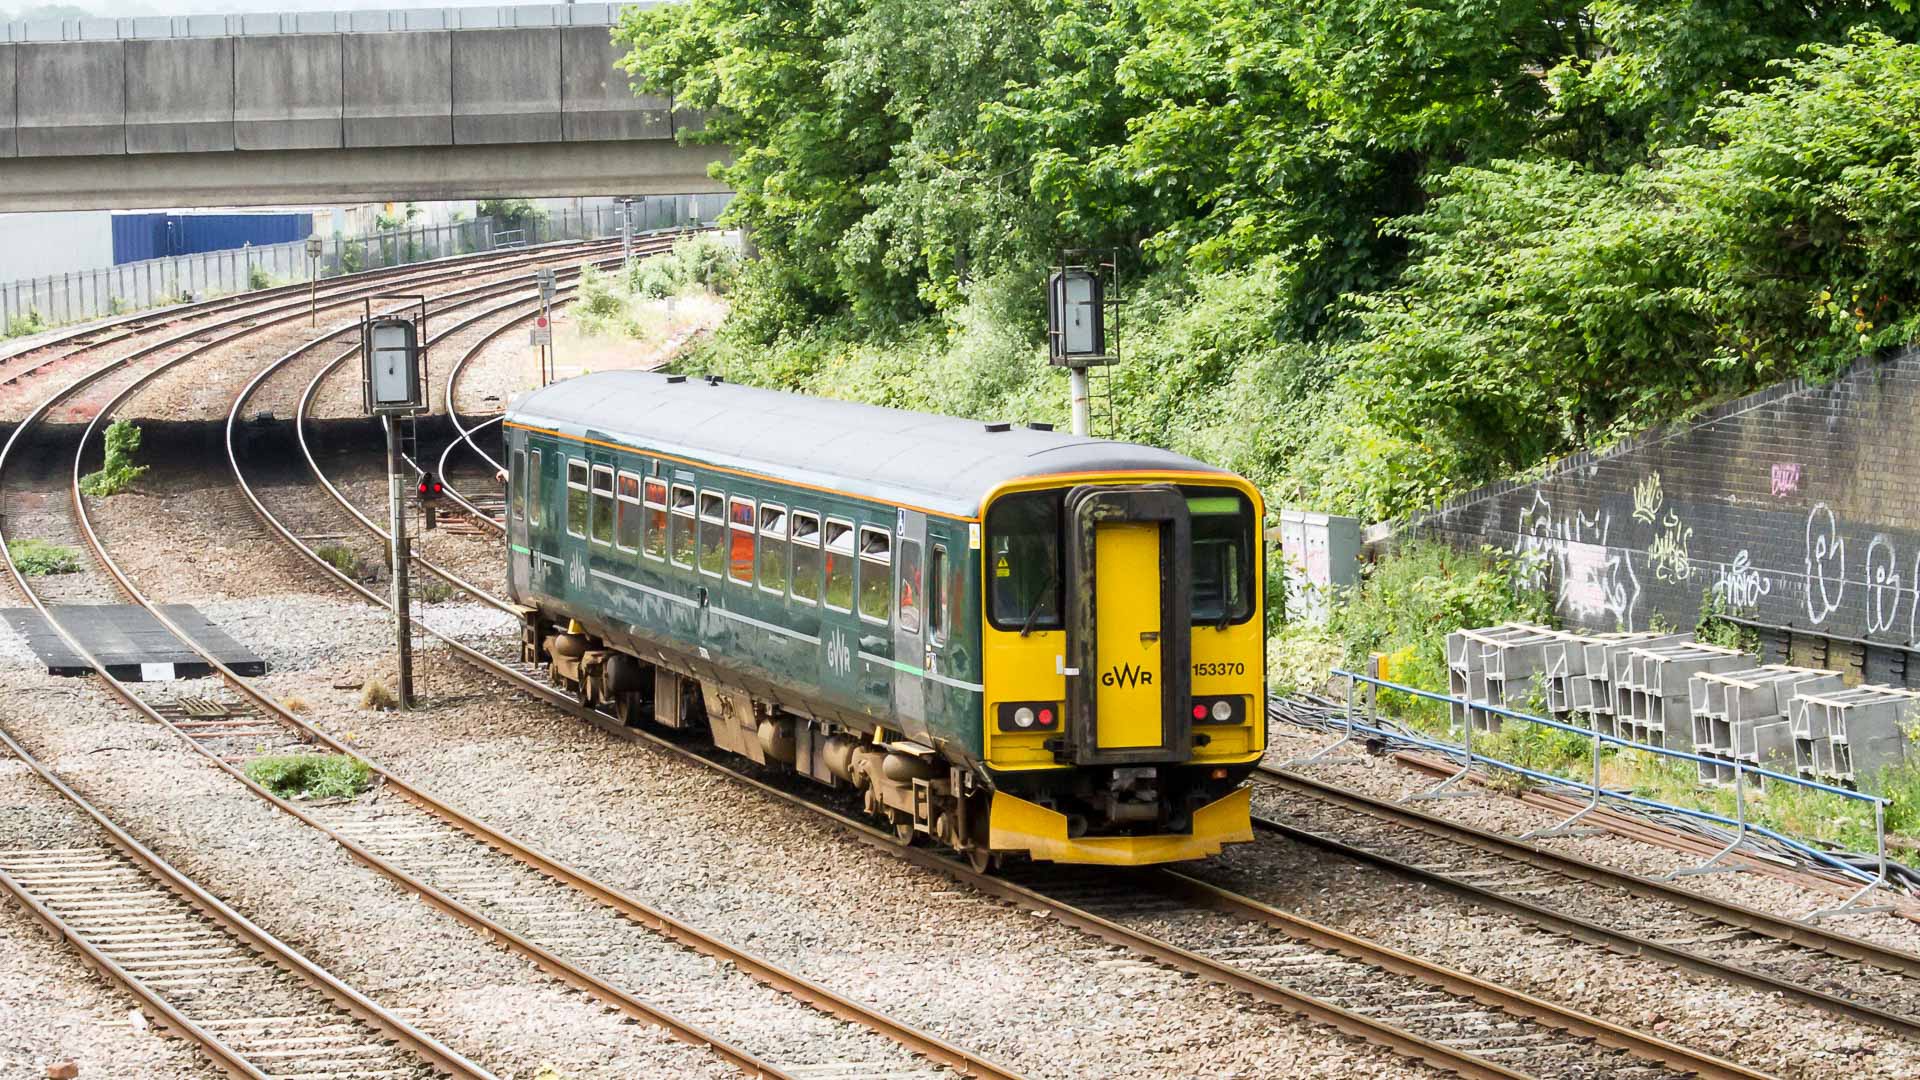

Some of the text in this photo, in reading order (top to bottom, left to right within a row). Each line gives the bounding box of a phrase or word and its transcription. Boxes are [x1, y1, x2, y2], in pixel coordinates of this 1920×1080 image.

[570, 548, 586, 592] GWR
[828, 626, 850, 678] GWR
[1192, 662, 1245, 676] 153370
[1102, 662, 1152, 689] GWR
